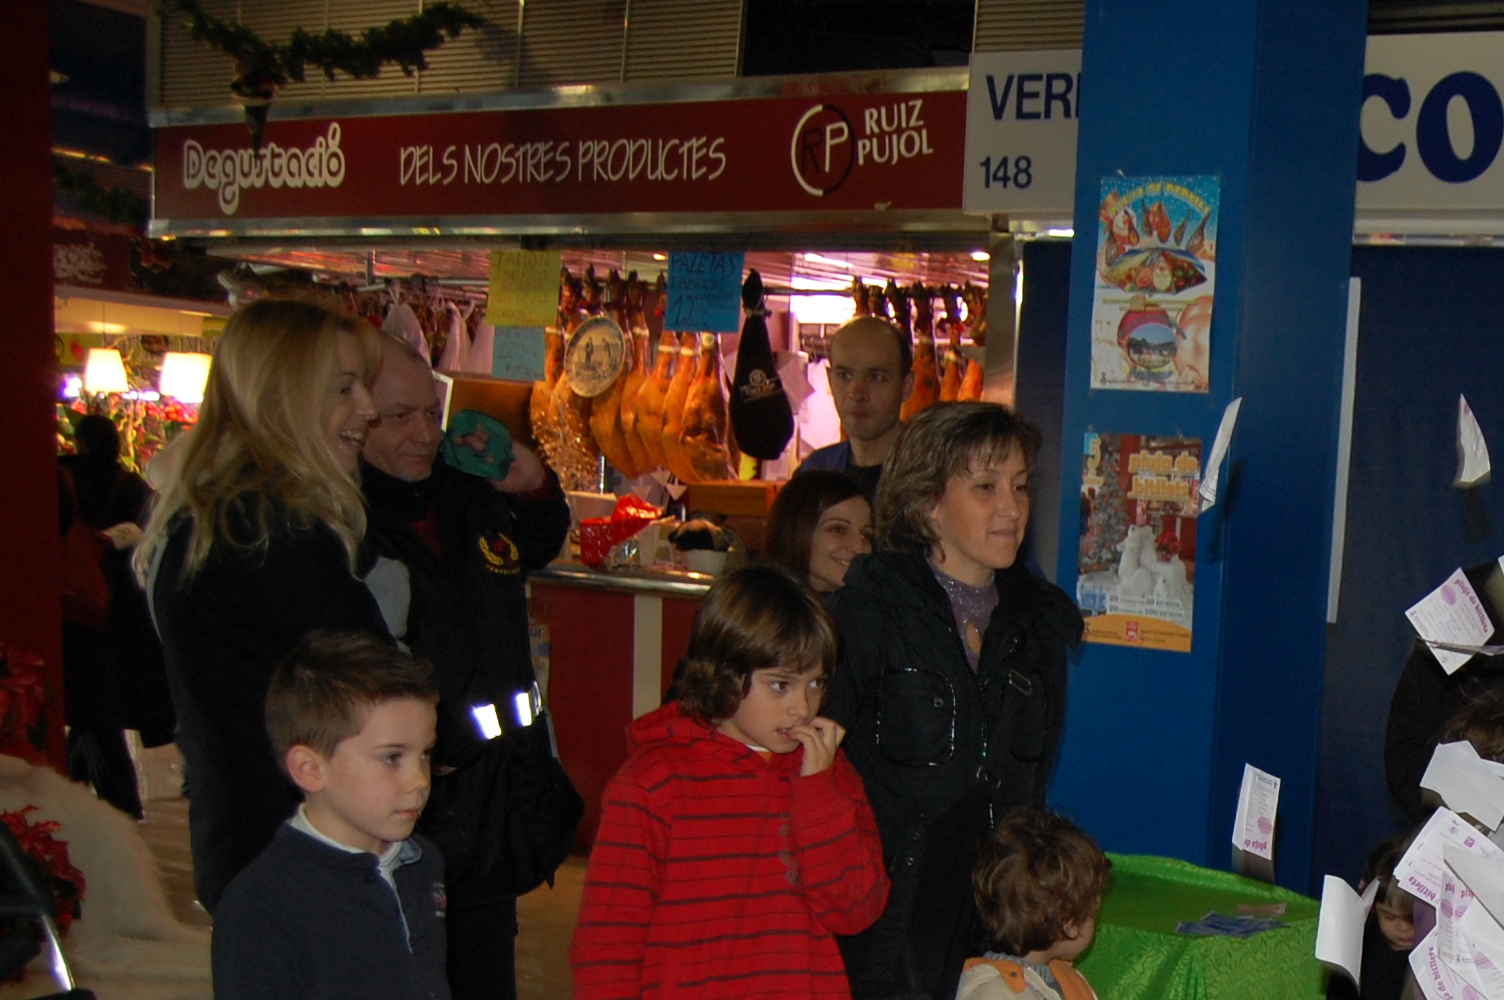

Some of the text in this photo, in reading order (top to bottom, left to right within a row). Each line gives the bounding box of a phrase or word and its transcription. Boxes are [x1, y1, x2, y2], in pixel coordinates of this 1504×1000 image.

[865, 99, 924, 135] RUIZ
[400, 136, 727, 186] DELS NOSTRES PRODUCTES
[857, 128, 934, 166] PUJOL
[184, 121, 345, 216] Degustació
[980, 155, 1032, 189] 148
[1129, 451, 1198, 473] pluja de
[1408, 876, 1437, 900] bitllets
[1428, 946, 1442, 981] bitllets
